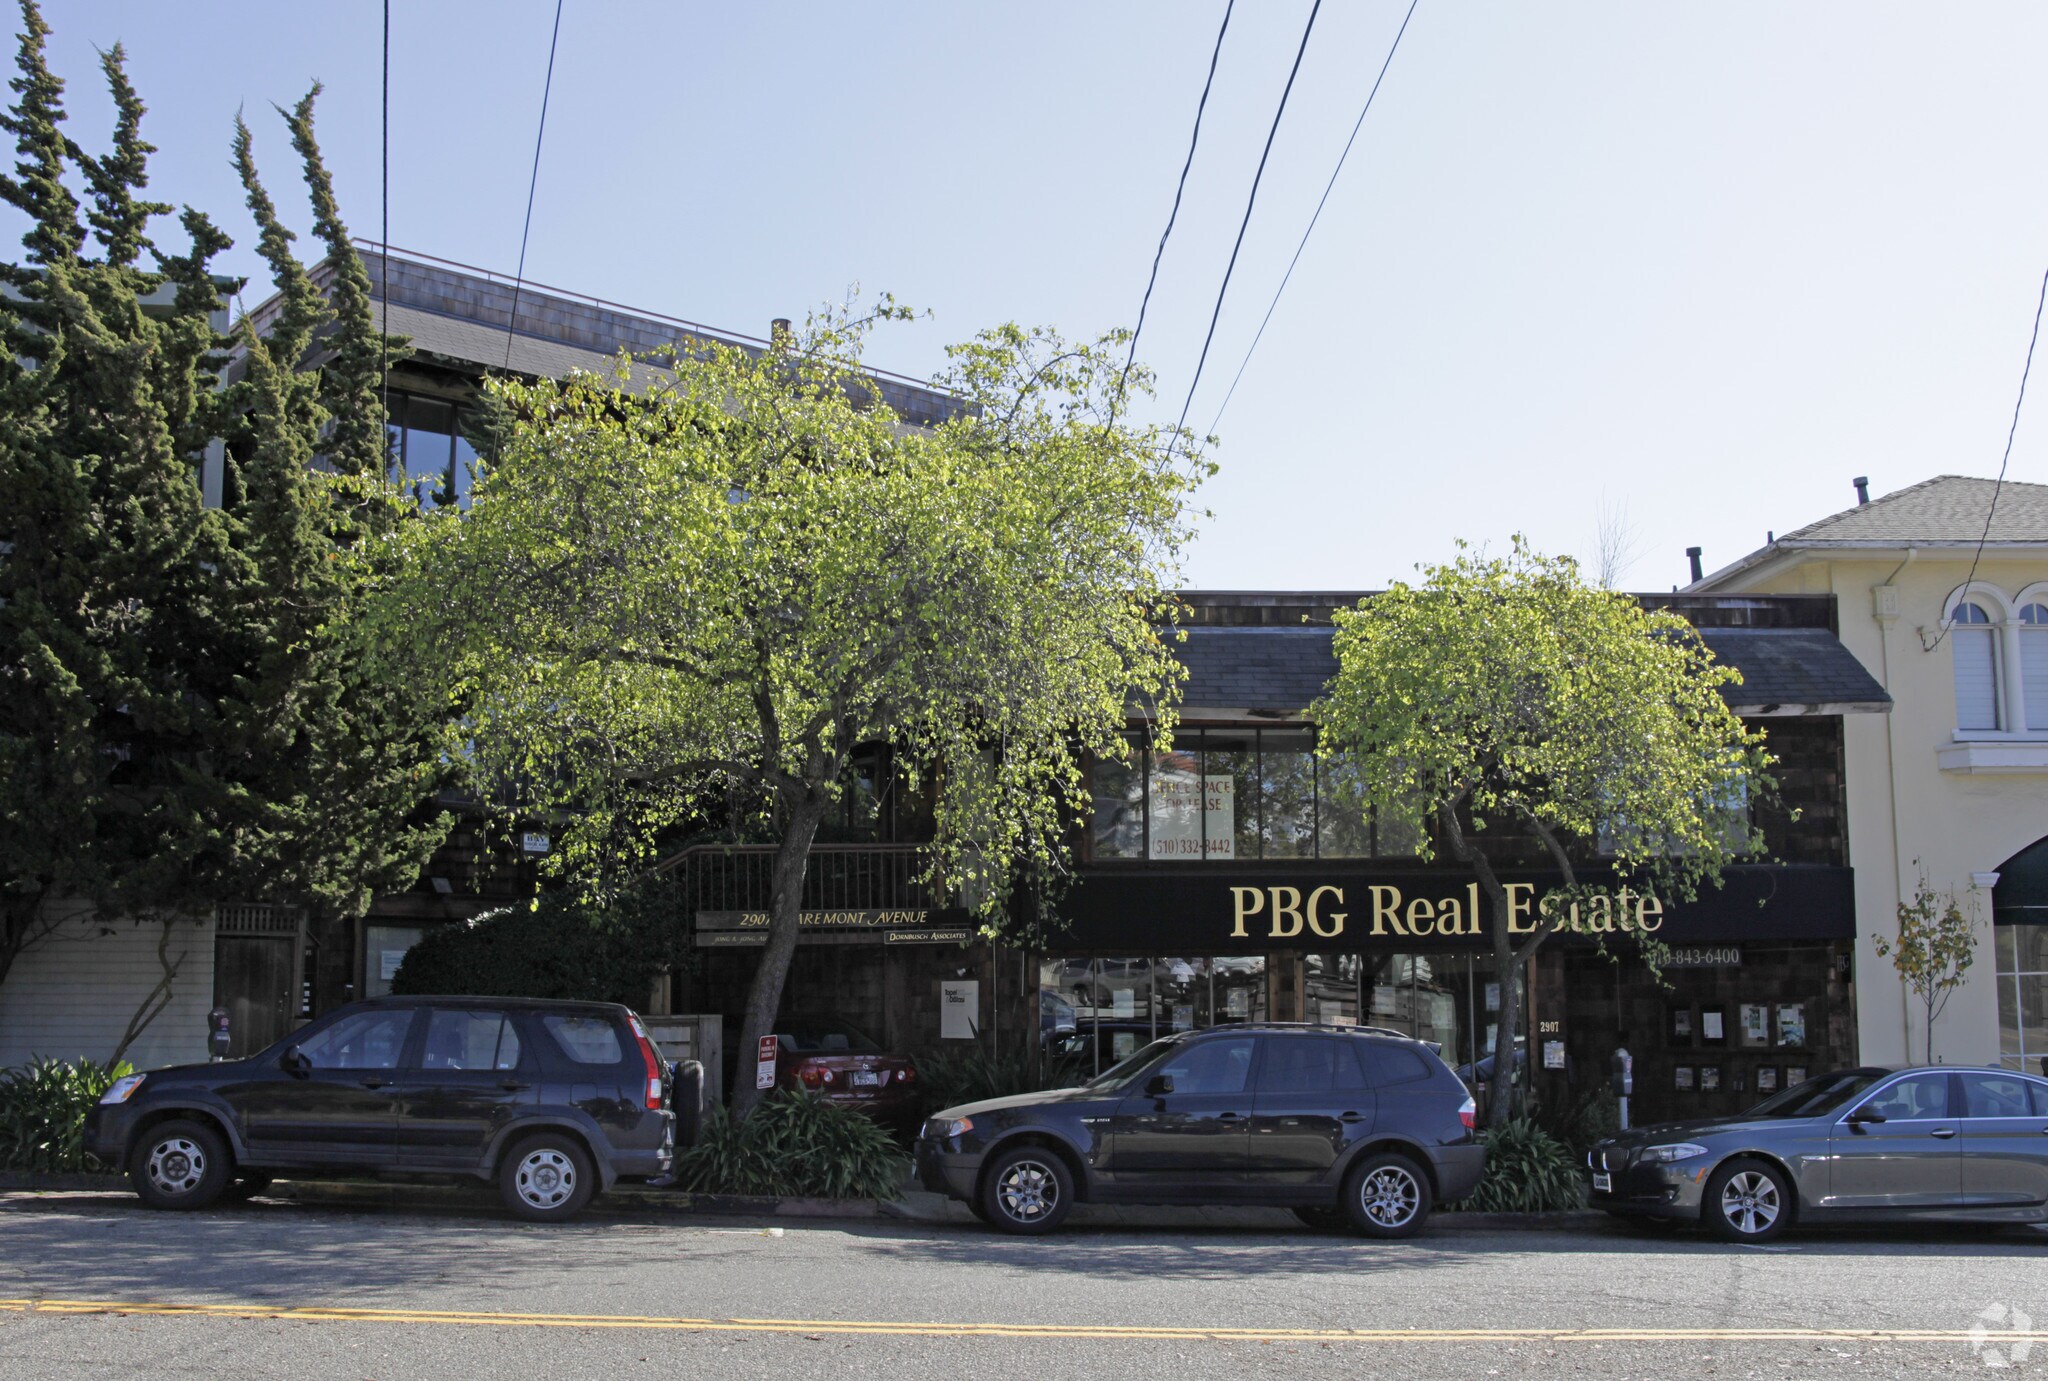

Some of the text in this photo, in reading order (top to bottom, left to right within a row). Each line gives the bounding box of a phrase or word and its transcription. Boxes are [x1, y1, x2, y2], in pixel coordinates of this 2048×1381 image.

[1230, 885, 1348, 937] PBG
[1368, 882, 1482, 936] Real
[867, 911, 928, 925] AVENUE
[1540, 1021, 1559, 1032] 2907
